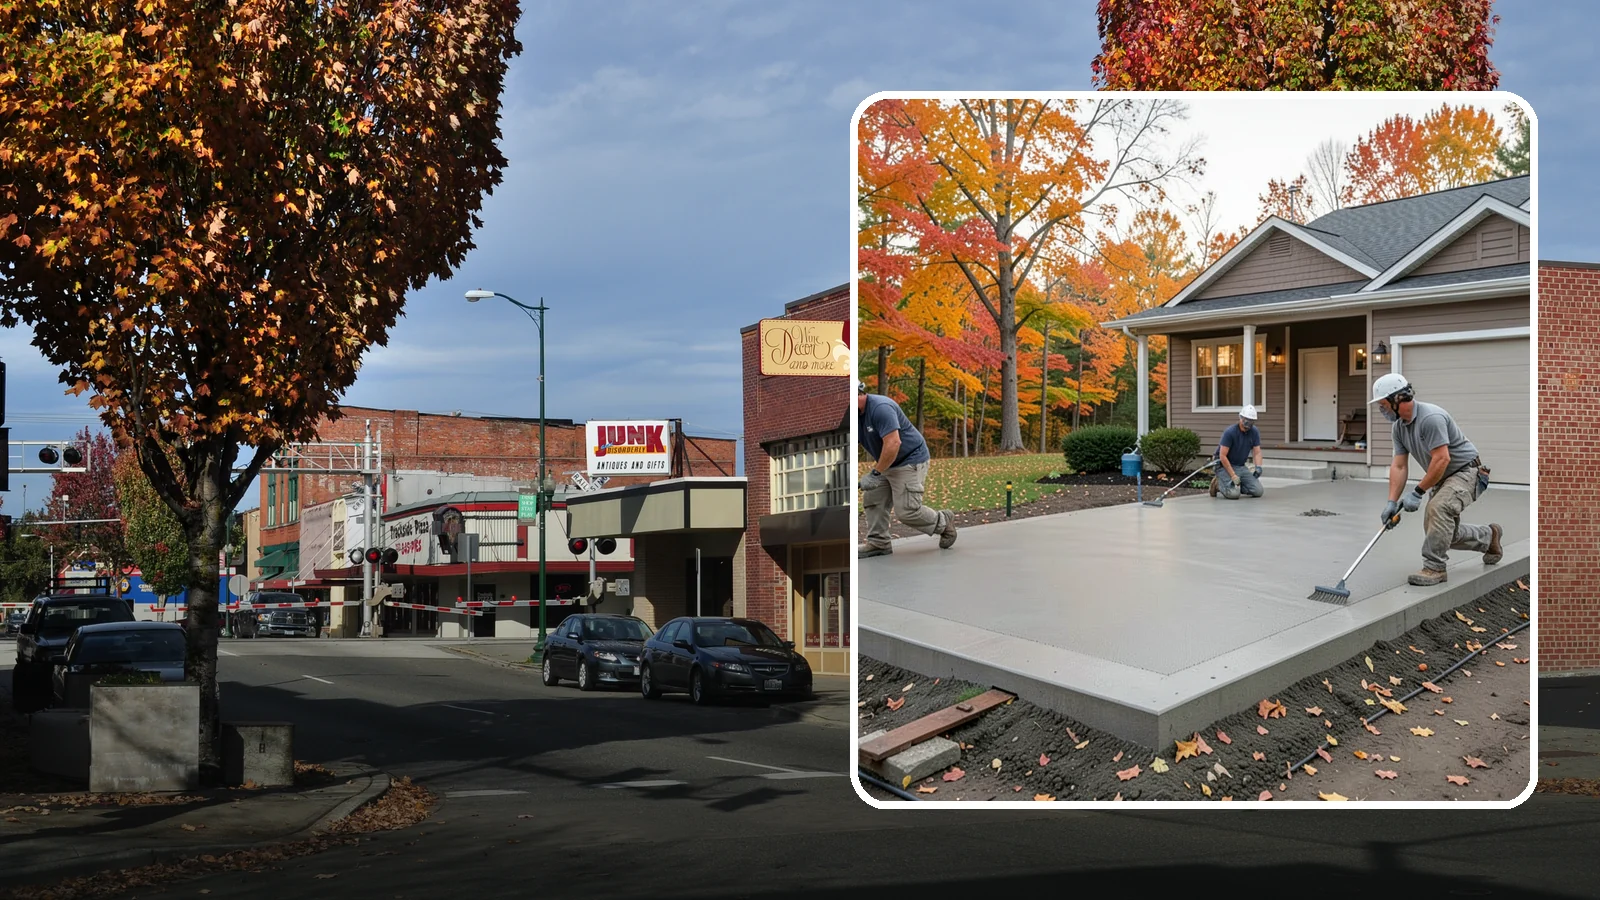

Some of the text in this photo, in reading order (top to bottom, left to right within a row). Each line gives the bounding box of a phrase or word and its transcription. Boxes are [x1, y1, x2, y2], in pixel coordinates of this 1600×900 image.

[765, 327, 831, 365] Decor
[596, 425, 665, 457] JUNK
[607, 446, 645, 454] DISORDERLY
[597, 460, 665, 470] ANTIQUES AND GIFTS
[390, 519, 429, 539] Trackside Pizza
